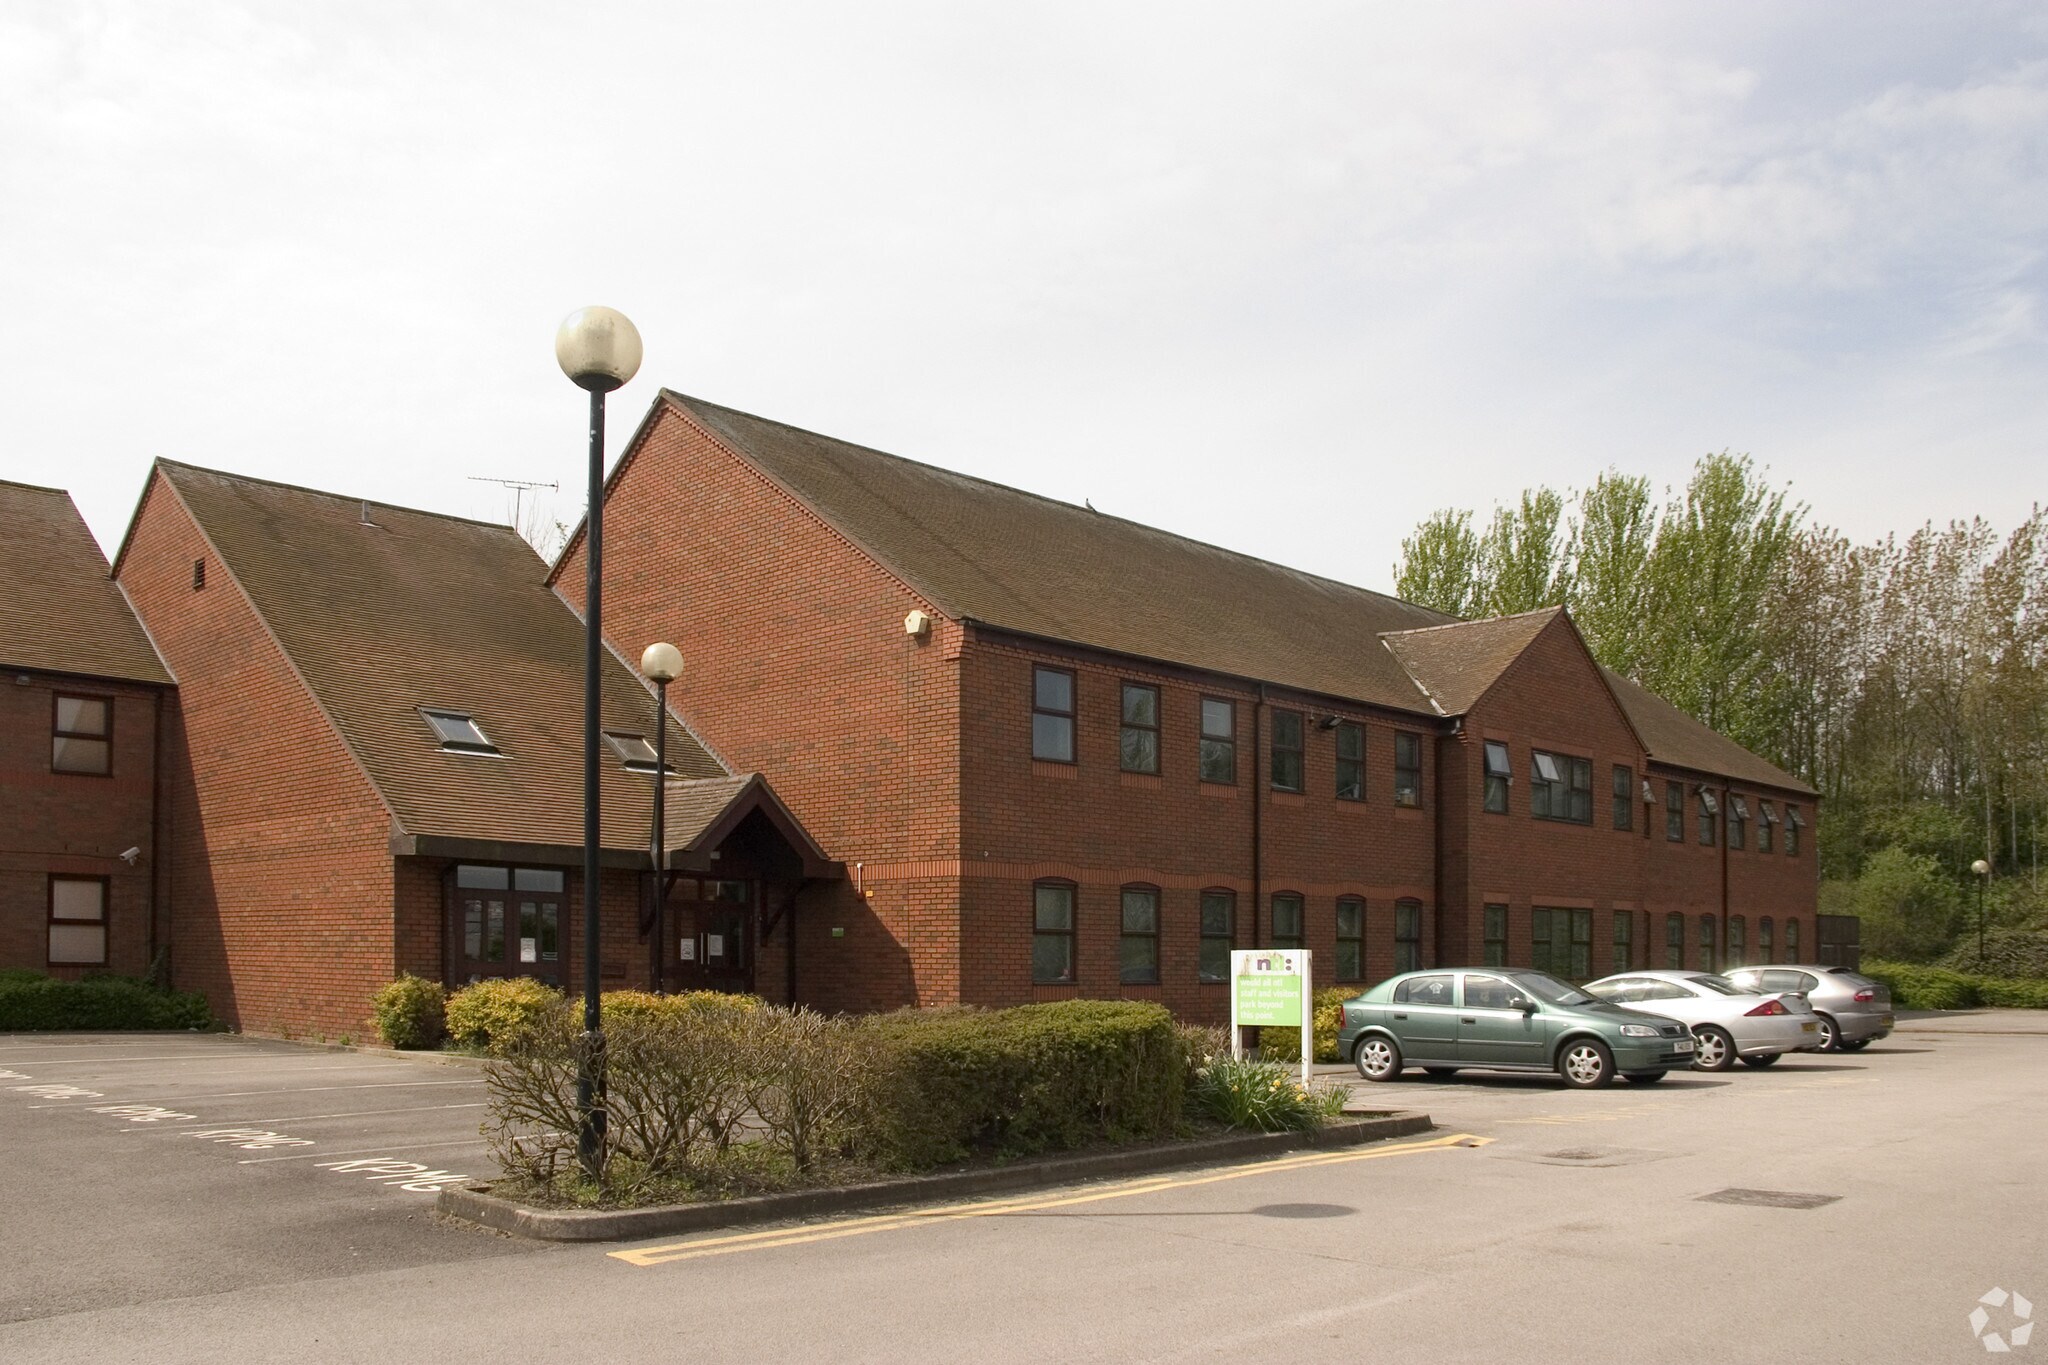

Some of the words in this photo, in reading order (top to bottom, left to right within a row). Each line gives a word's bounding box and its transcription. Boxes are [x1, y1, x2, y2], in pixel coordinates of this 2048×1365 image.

[1241, 989, 1256, 997] staff
[1259, 989, 1271, 997] and
[1240, 1000, 1256, 1009] park
[1258, 1000, 1284, 1010] beyond
[1241, 1011, 1254, 1019] this
[180, 1128, 316, 1149] KPMG
[313, 1157, 472, 1192] KPMG
